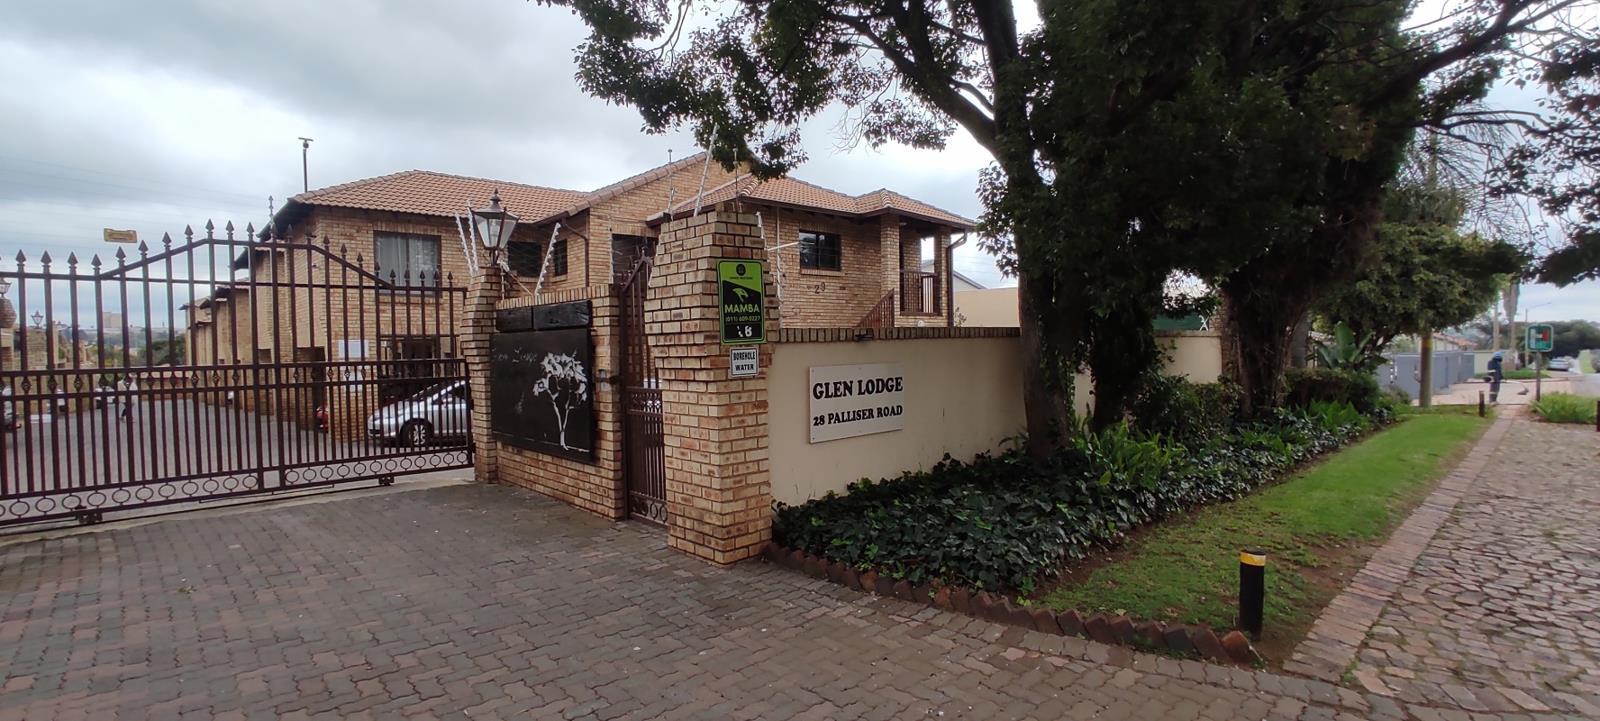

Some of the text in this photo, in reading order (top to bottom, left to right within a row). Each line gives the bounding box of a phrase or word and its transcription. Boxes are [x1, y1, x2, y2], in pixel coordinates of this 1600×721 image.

[724, 303, 760, 313] MAMBA
[733, 351, 755, 361] BOREHOLE
[813, 376, 903, 400] GLEN LODGE
[813, 405, 903, 426] 28 PALLISER ROAD
